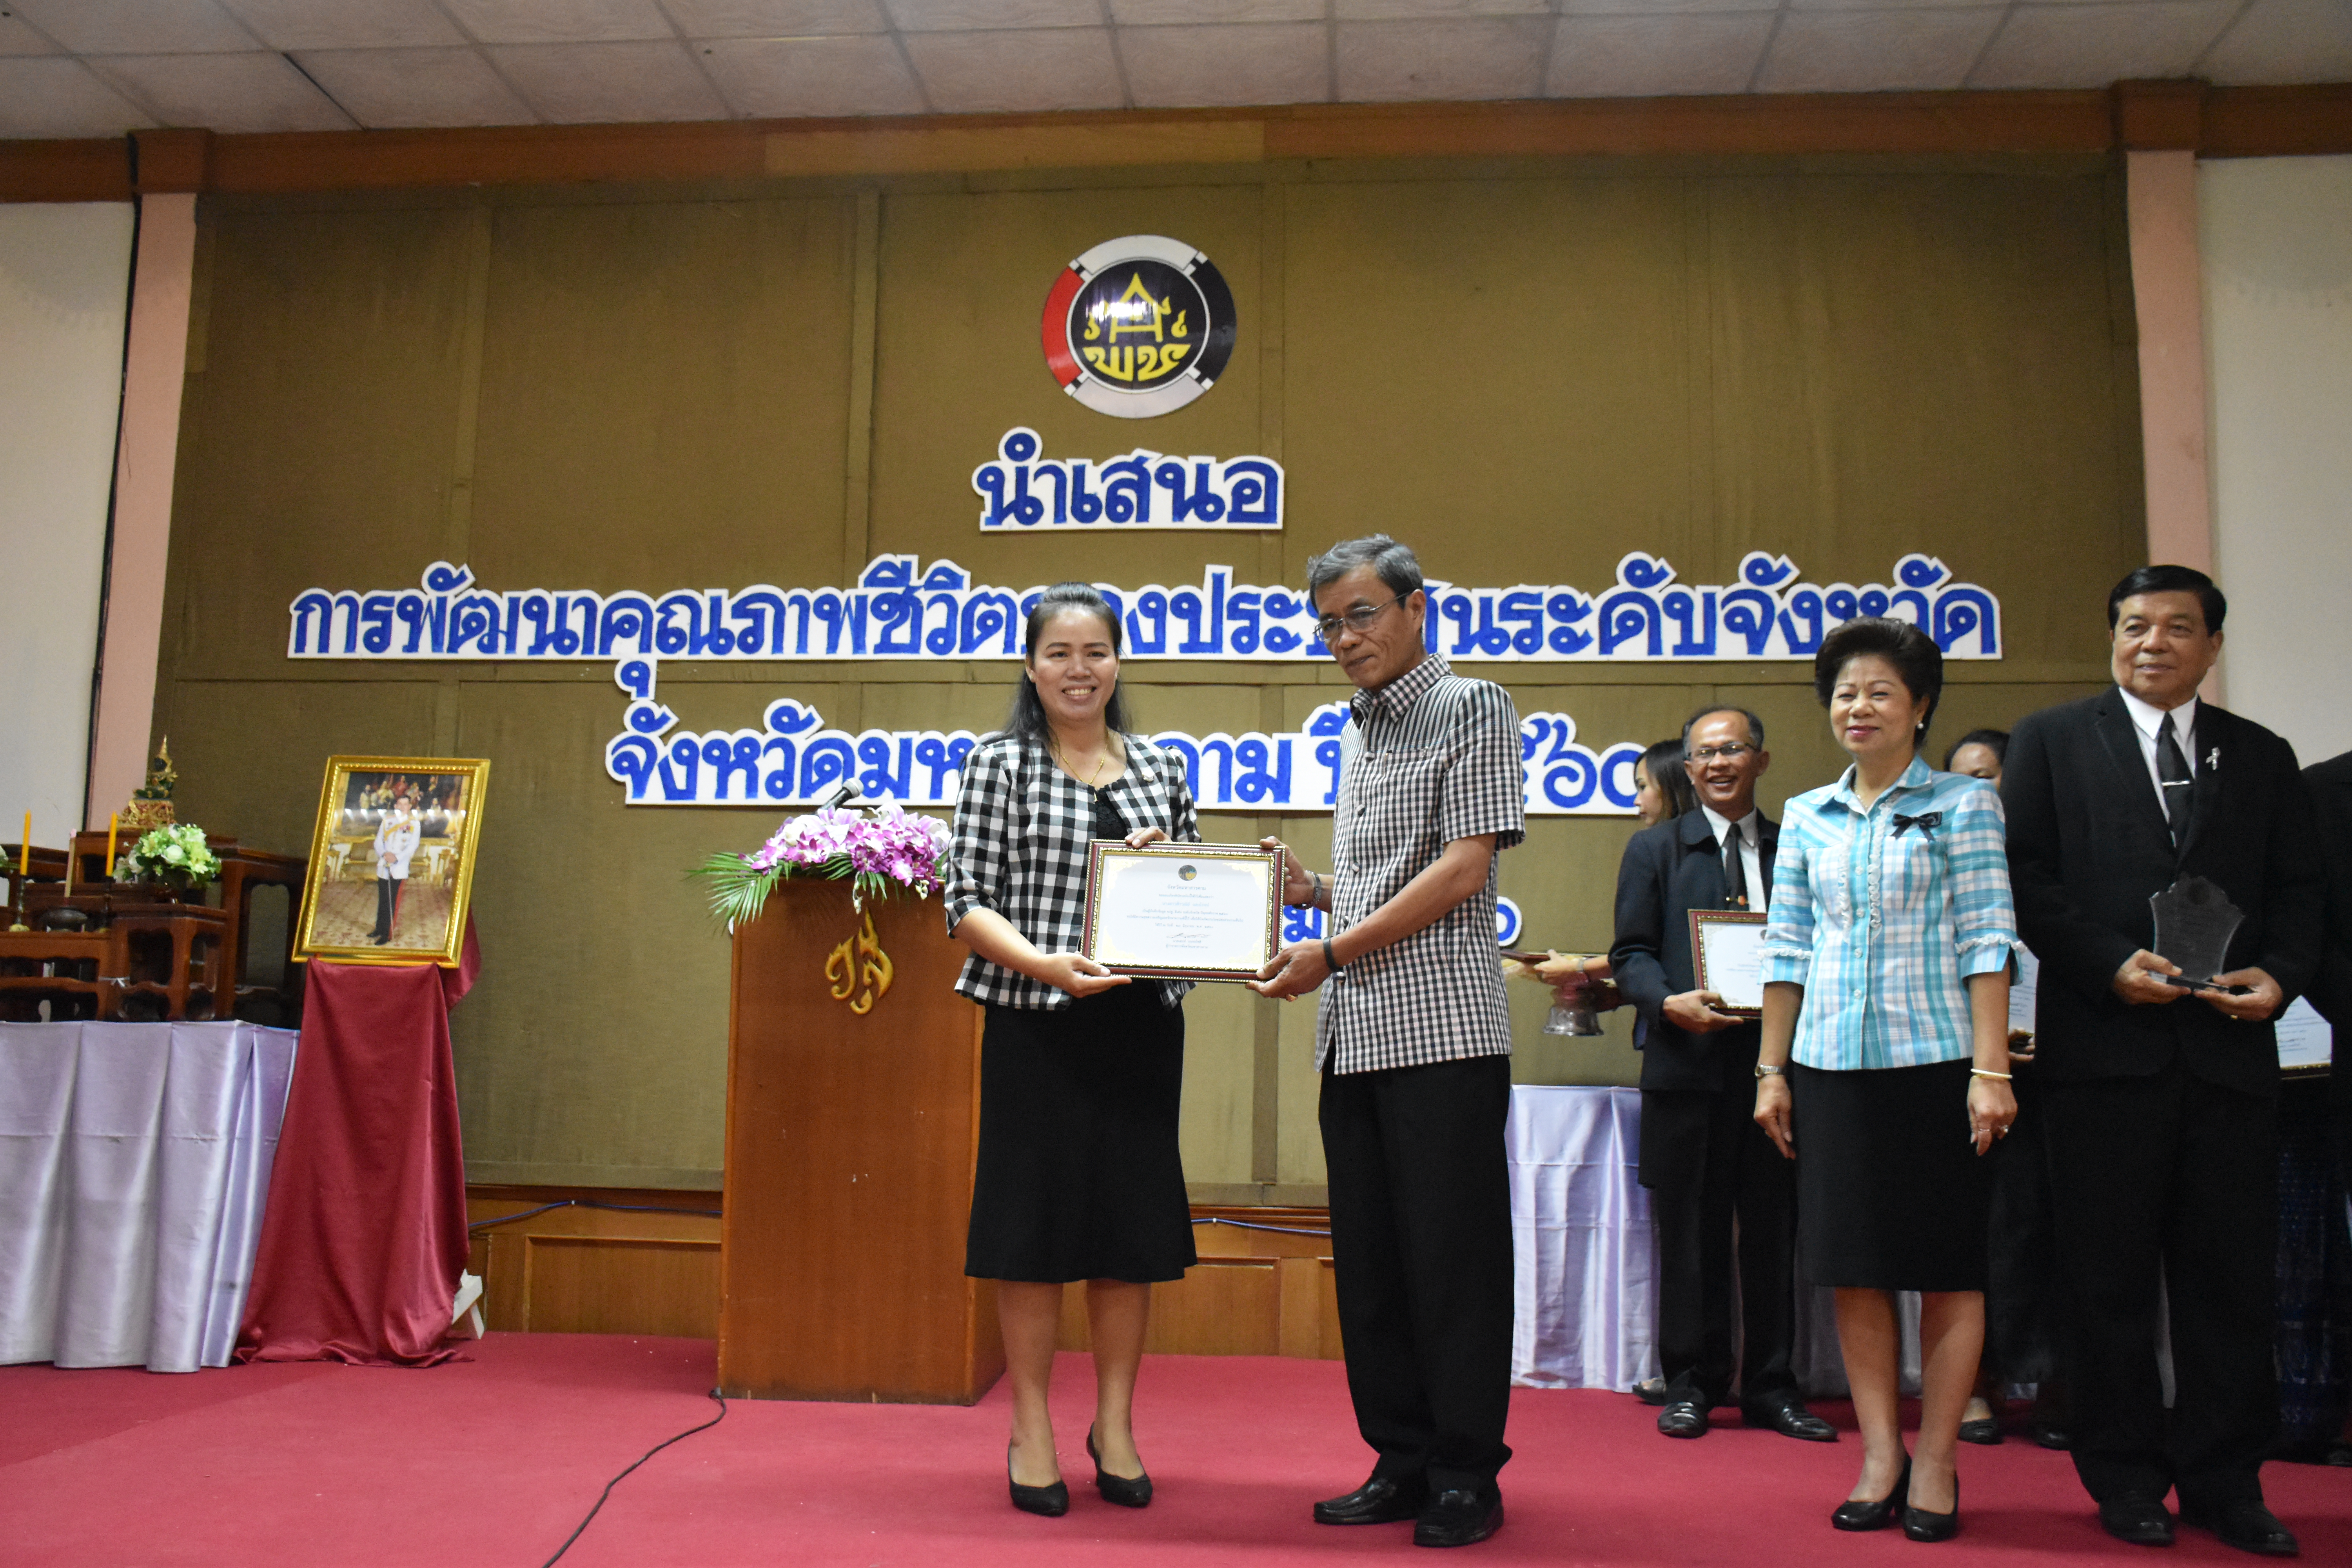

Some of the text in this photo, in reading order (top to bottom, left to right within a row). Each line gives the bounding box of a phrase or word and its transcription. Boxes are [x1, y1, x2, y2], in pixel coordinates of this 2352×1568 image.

[976, 432, 1278, 525] นำเสนอ
[294, 557, 1996, 698] การพัฒนาคุณภาพชีวิตงประนระดับจังหวัด
[611, 705, 1292, 803] จังหวัดมหาม
